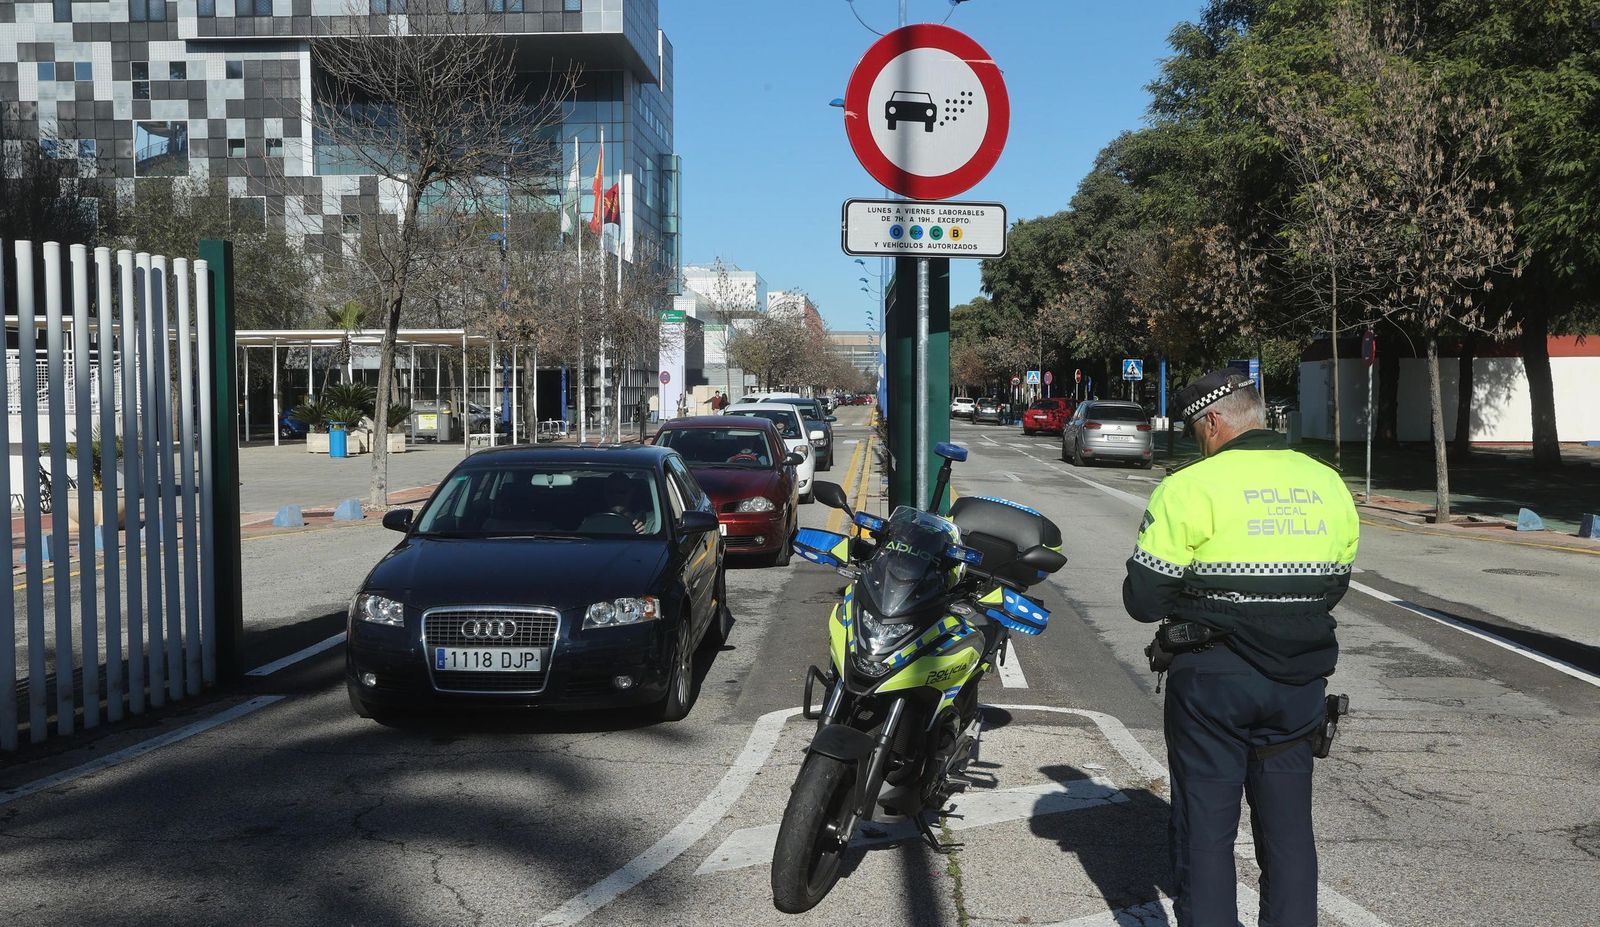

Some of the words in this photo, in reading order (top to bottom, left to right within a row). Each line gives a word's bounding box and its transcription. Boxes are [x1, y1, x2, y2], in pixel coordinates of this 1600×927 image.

[938, 208, 985, 216] LABORABLES
[932, 228, 940, 238] C
[952, 229, 959, 238] B
[882, 240, 924, 249] VEHÍCULOS
[927, 242, 978, 250] AUTORIZADOS
[1243, 487, 1324, 504] POLICIA
[1267, 506, 1307, 516] LOCAL
[1247, 519, 1328, 536] SEVILLA
[451, 651, 492, 668] 1118
[501, 652, 534, 669] DJP
